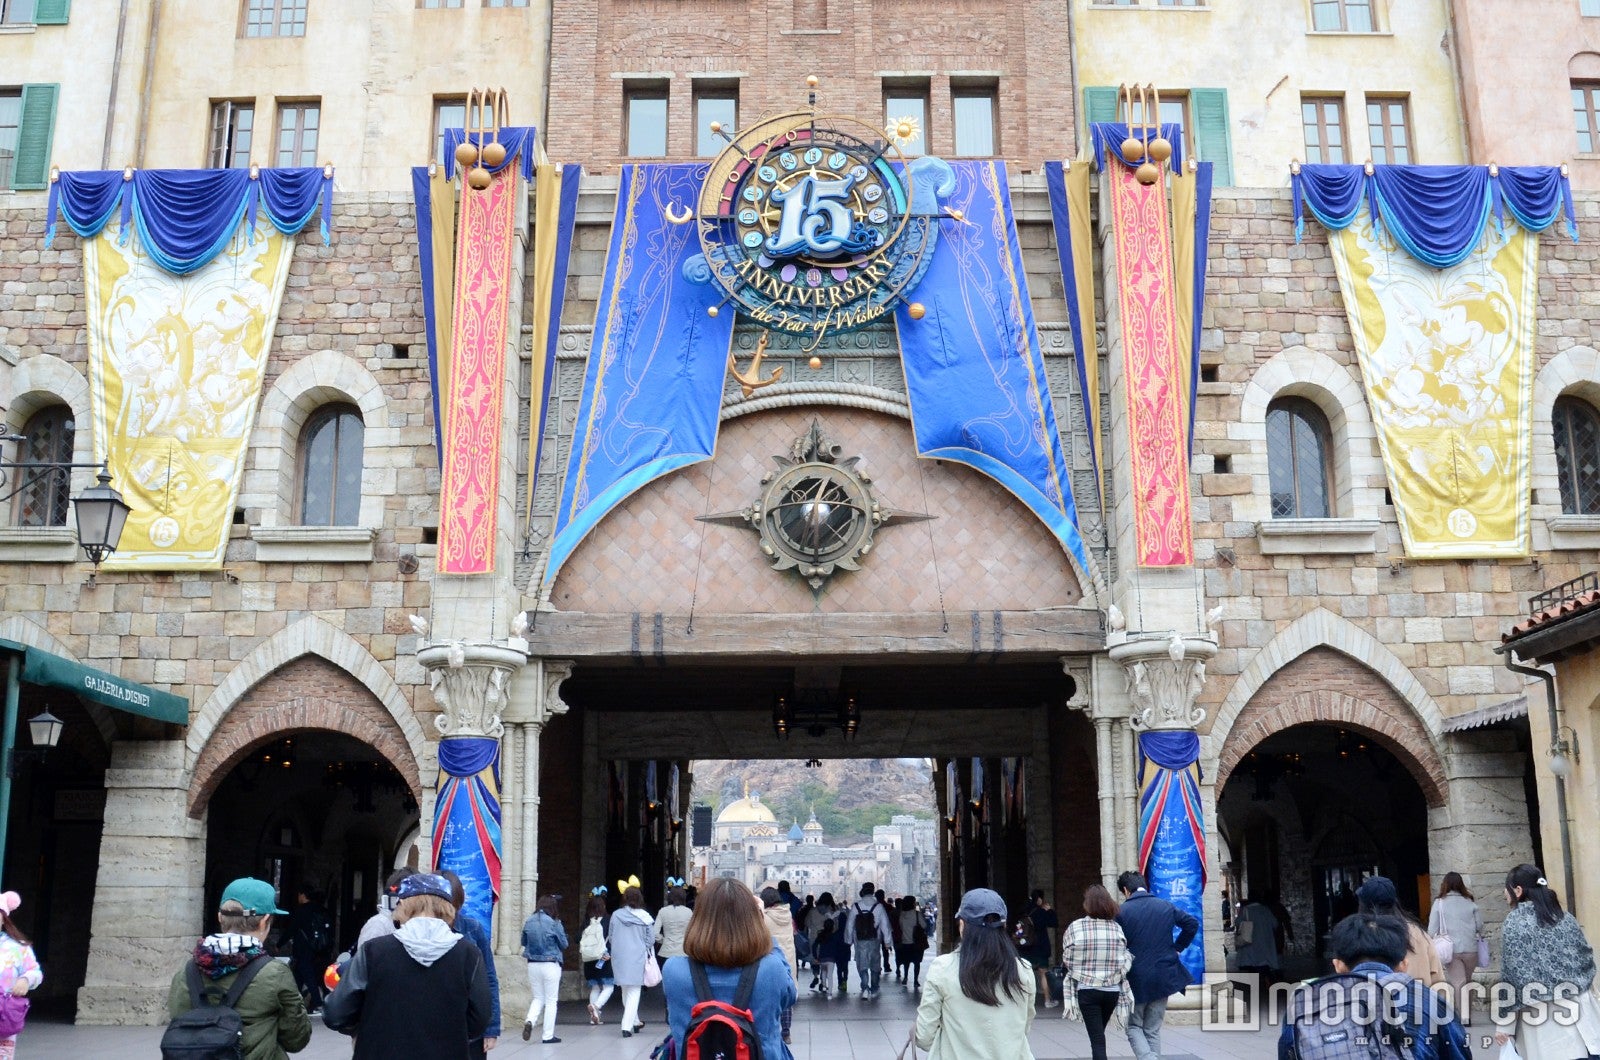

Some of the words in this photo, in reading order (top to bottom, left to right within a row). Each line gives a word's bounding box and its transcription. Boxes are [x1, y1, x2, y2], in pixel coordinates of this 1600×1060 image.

[719, 129, 798, 202] TOKYO
[764, 174, 857, 253] 15
[734, 252, 894, 306] ANNIVERSARY
[750, 300, 786, 324] the
[777, 310, 810, 332] Year
[801, 302, 840, 352] of
[835, 288, 886, 330] Wishes
[153, 520, 173, 543] 15
[1451, 513, 1471, 533] 15
[84, 675, 125, 700] GALLERIA
[125, 690, 151, 707] DISNEY
[1169, 877, 1188, 896] 15
